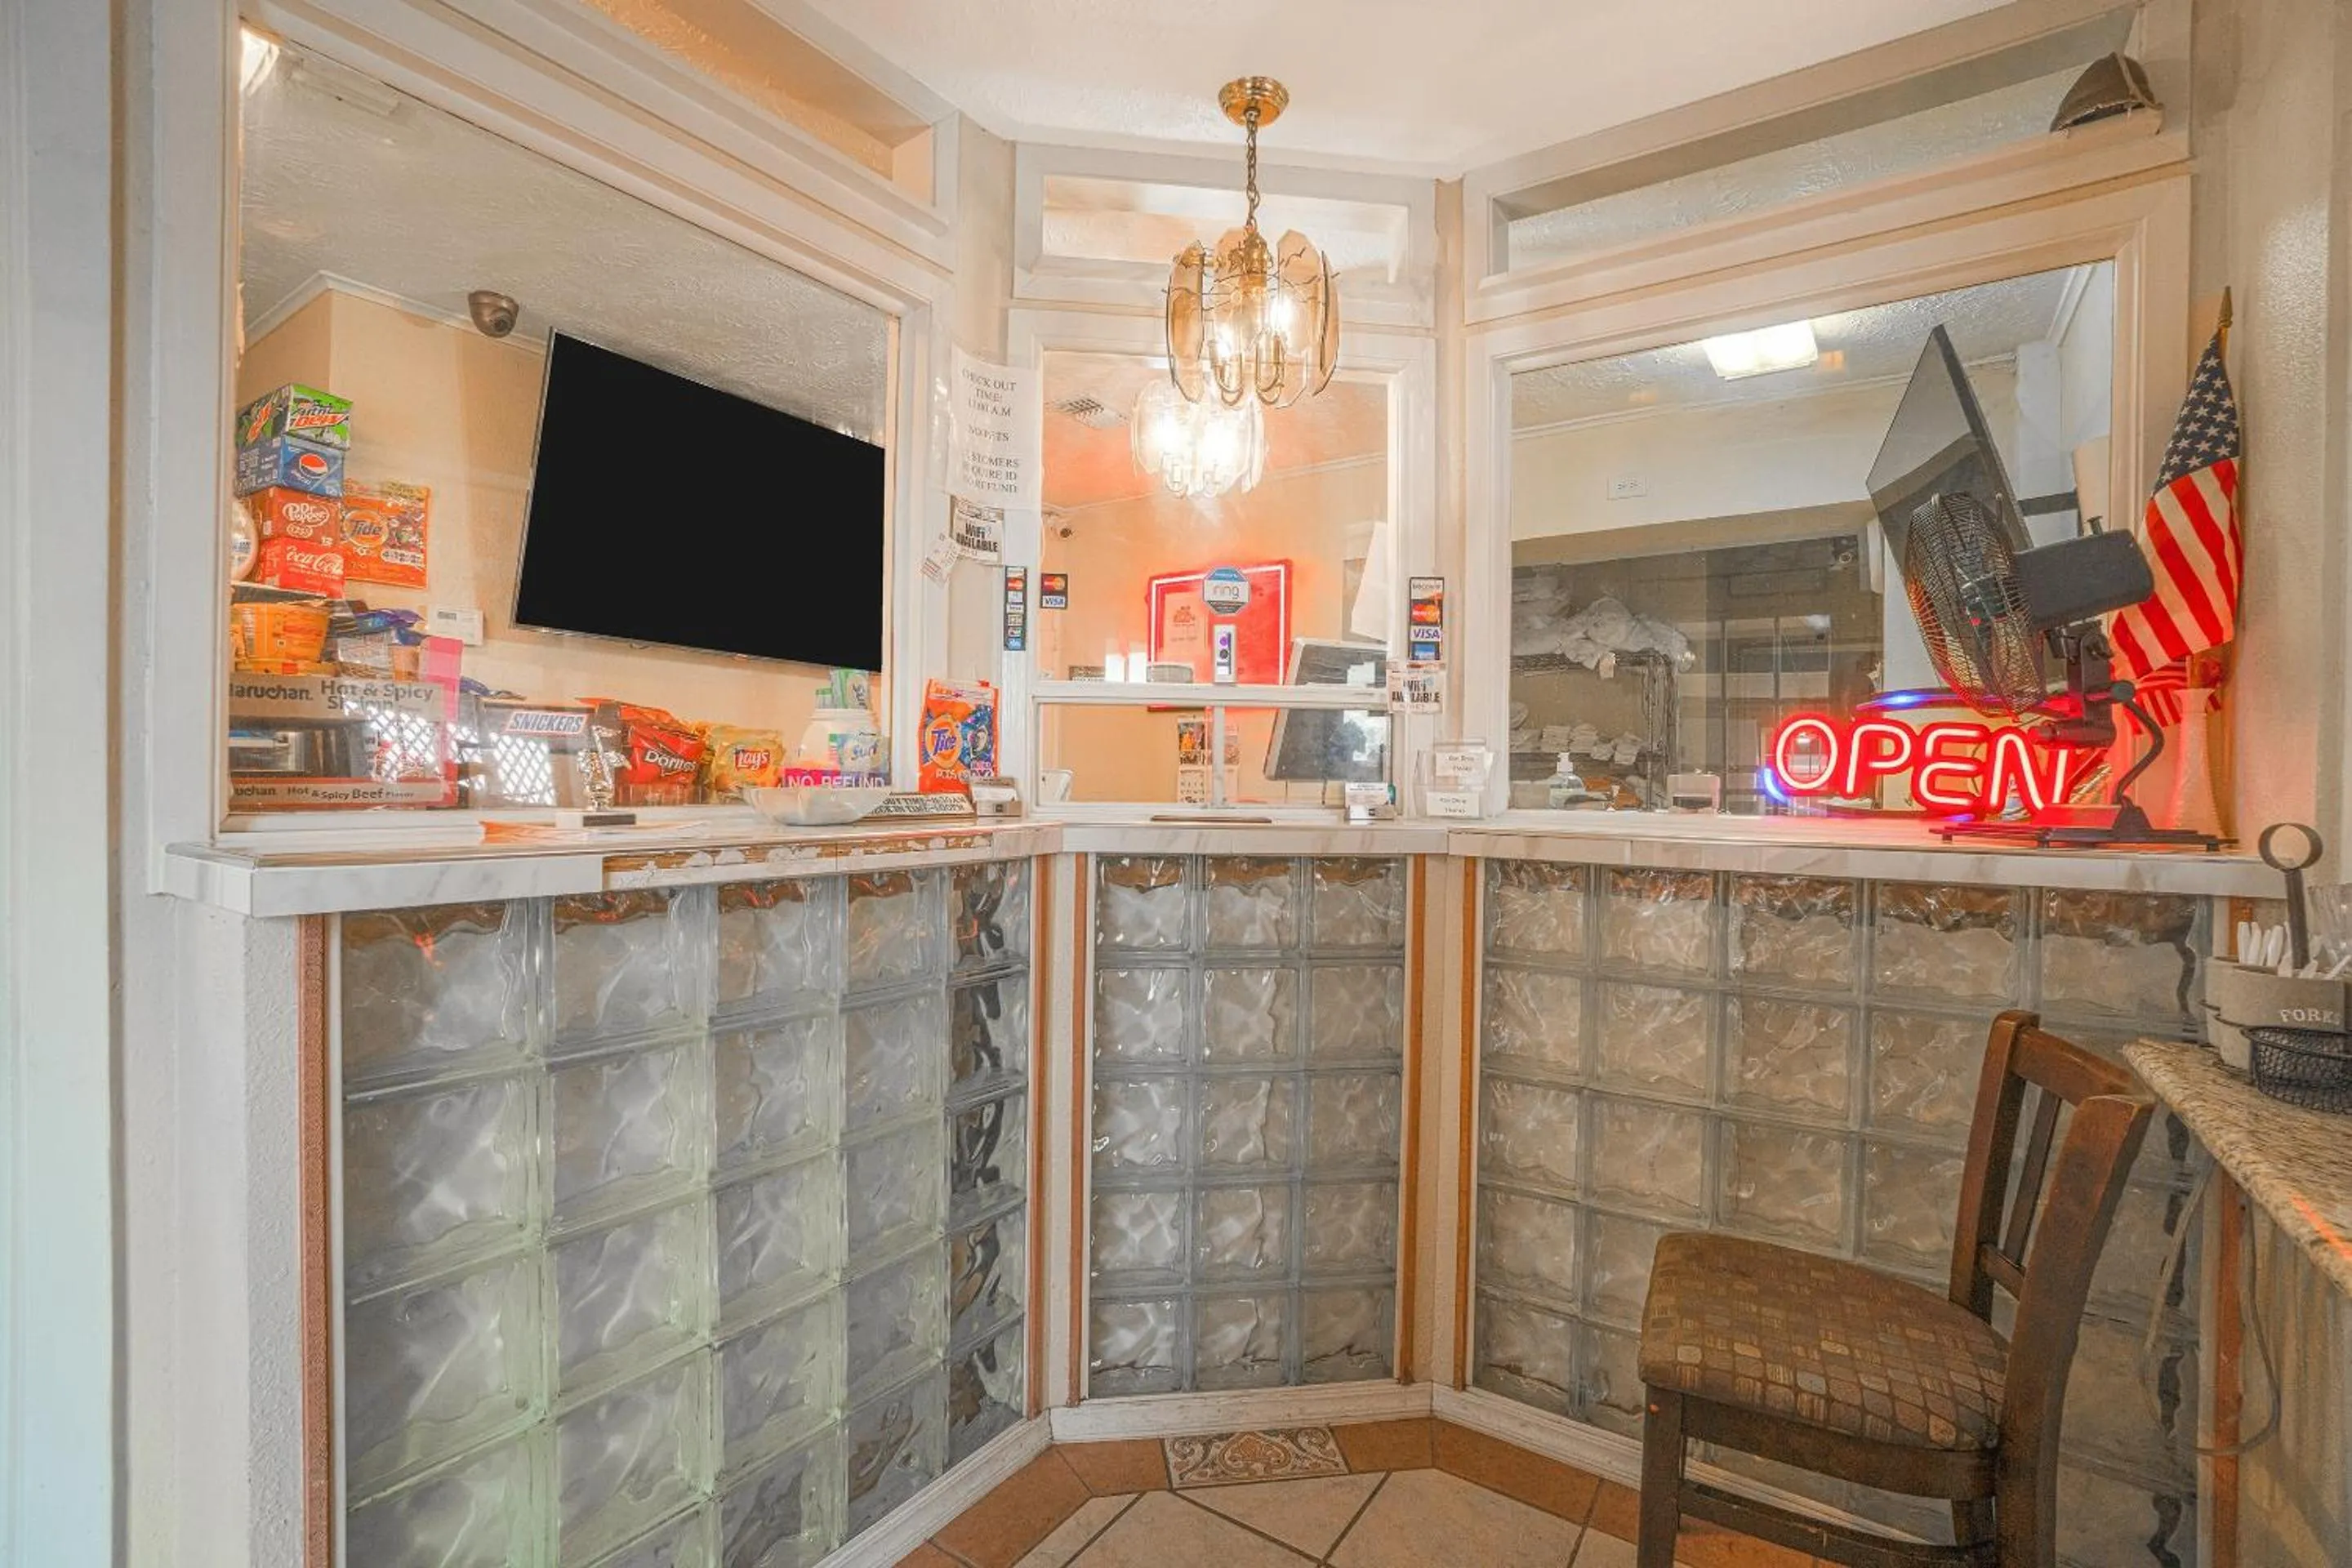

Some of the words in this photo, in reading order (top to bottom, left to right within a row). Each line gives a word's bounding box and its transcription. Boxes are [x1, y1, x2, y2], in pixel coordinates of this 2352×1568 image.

[956, 532, 998, 553] AVAILABLE
[1213, 585, 1240, 599] ring
[1045, 598, 1064, 606] VISA
[1413, 628, 1441, 639] VISA
[320, 679, 358, 696] Hot
[363, 683, 379, 697] &
[382, 683, 434, 702] Spicy
[1392, 691, 1440, 703] AVALABLE
[511, 712, 583, 733] SNICKERS
[931, 728, 957, 756] Tide
[1774, 717, 2069, 811] OPEN
[234, 786, 276, 797] uchan
[287, 786, 309, 795] Hot
[321, 791, 350, 800] Spicy
[352, 787, 384, 799] Beef
